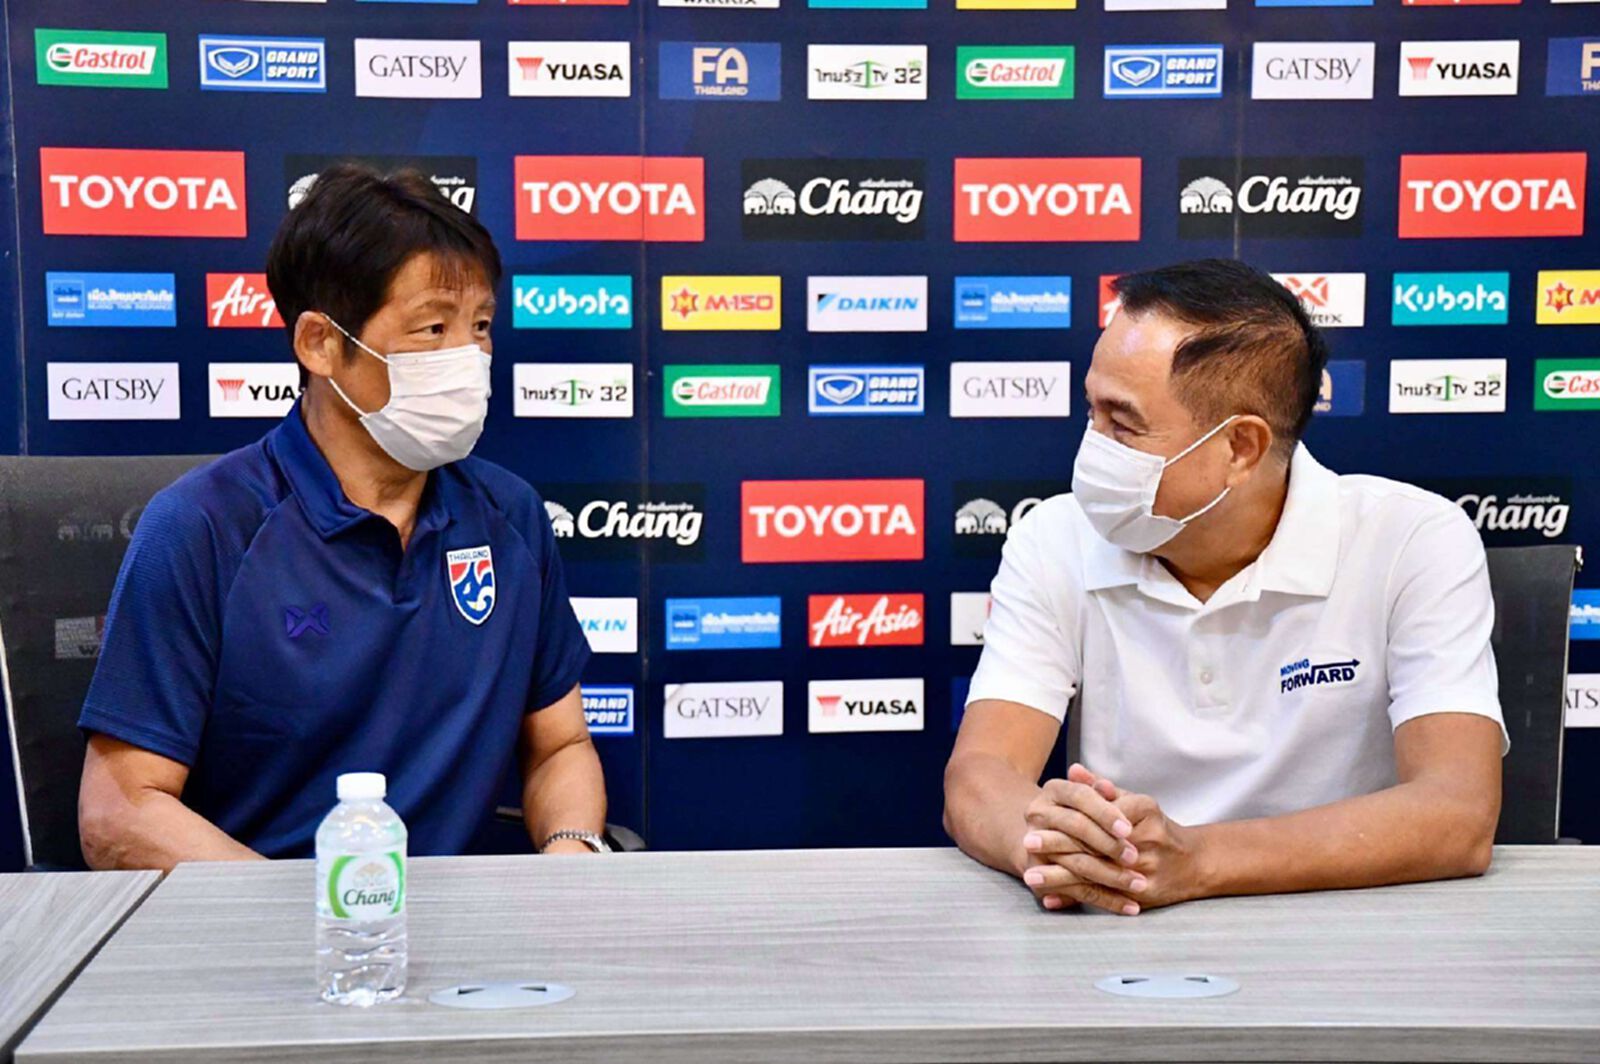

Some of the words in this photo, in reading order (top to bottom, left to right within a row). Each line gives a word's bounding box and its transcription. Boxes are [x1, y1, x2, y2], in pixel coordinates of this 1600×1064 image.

[73, 47, 146, 70] Castrol
[266, 51, 318, 64] GRAND
[693, 48, 749, 84] FA
[1167, 57, 1216, 70] GRAND
[267, 65, 318, 79] SPORT
[369, 55, 467, 82] GATSBY
[546, 63, 623, 80] YUASA
[873, 69, 888, 82] TV
[894, 68, 922, 84] 32
[990, 62, 1055, 83] Castrol
[1166, 71, 1215, 85] SPORT
[1266, 58, 1361, 84] GATSBY
[1436, 62, 1511, 80] YUASA
[694, 85, 748, 96] THAILAND
[49, 174, 237, 210] TOYOTA
[522, 181, 696, 216] TOYOTA
[800, 177, 923, 224] Chang
[962, 183, 1132, 216] TOYOTA
[1238, 175, 1361, 220] Chang
[1407, 178, 1576, 213] TOYOTA
[515, 287, 630, 315] Kubota
[704, 295, 773, 311] M-150
[838, 296, 919, 311] DAIKIN
[1395, 284, 1506, 312] Kubota
[62, 378, 164, 404] GATSBY
[698, 381, 761, 400] Castrol
[869, 376, 918, 390] GRAND
[963, 377, 1057, 402] GATSBY
[1453, 383, 1468, 395] TV
[1473, 380, 1501, 397] 32
[248, 385, 305, 401] YUA
[578, 388, 594, 400] TV
[600, 385, 627, 402] 32
[869, 390, 917, 404] SPORT
[577, 500, 703, 546] Chang
[749, 504, 916, 538] TOYOTA
[449, 549, 489, 561] THAILAND
[581, 619, 627, 631] IKIN
[1280, 658, 1310, 676] MOVING
[1281, 665, 1356, 693] FORWARD
[677, 697, 771, 722] GATSBY
[844, 699, 917, 716] YUASA
[343, 887, 396, 906] Chang
